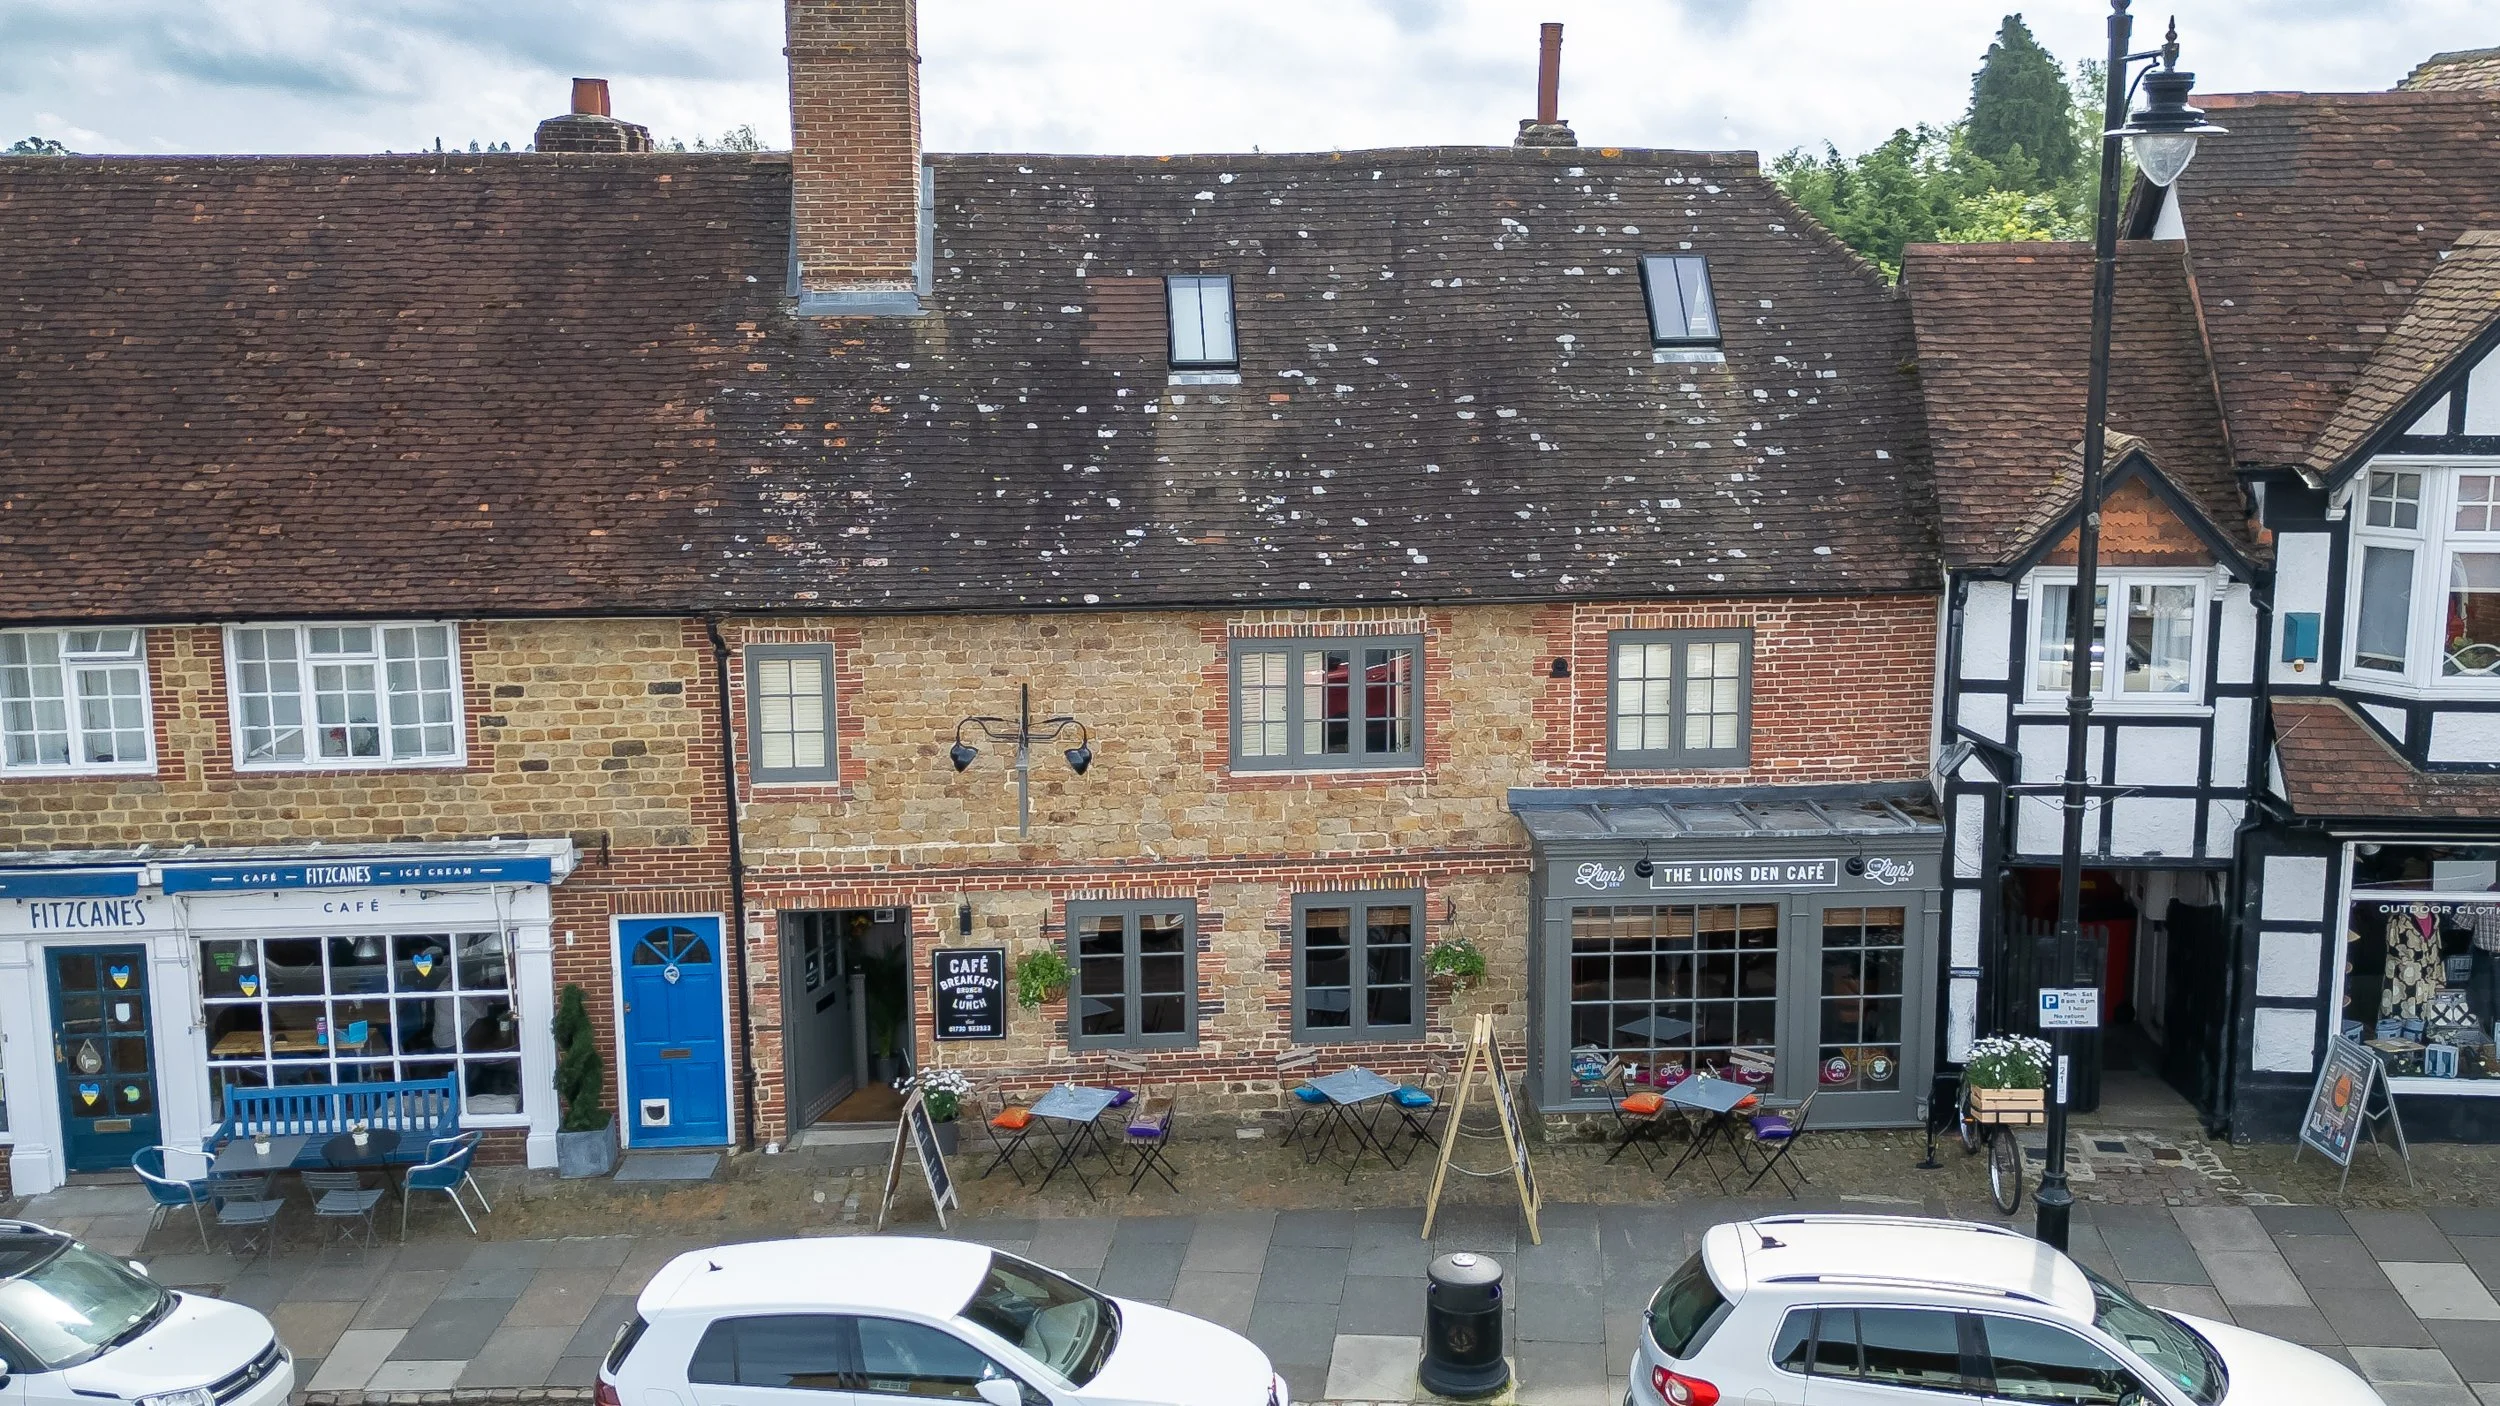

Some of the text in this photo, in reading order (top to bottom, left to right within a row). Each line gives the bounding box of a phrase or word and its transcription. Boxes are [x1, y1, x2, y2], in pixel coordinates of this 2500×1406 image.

[399, 868, 421, 877] ICE
[428, 867, 472, 876] CREAM
[1663, 862, 1825, 883] THE LIONS DEN CAFÉ
[323, 898, 380, 913] CAFÉ
[2379, 904, 2452, 914] OUTDOOR
[30, 899, 146, 929] FITZCANE'S
[950, 955, 988, 973] CAFÉ
[940, 975, 999, 990] BREAKFAST
[952, 998, 987, 1010] LUNCH
[2045, 995, 2057, 1009] P
